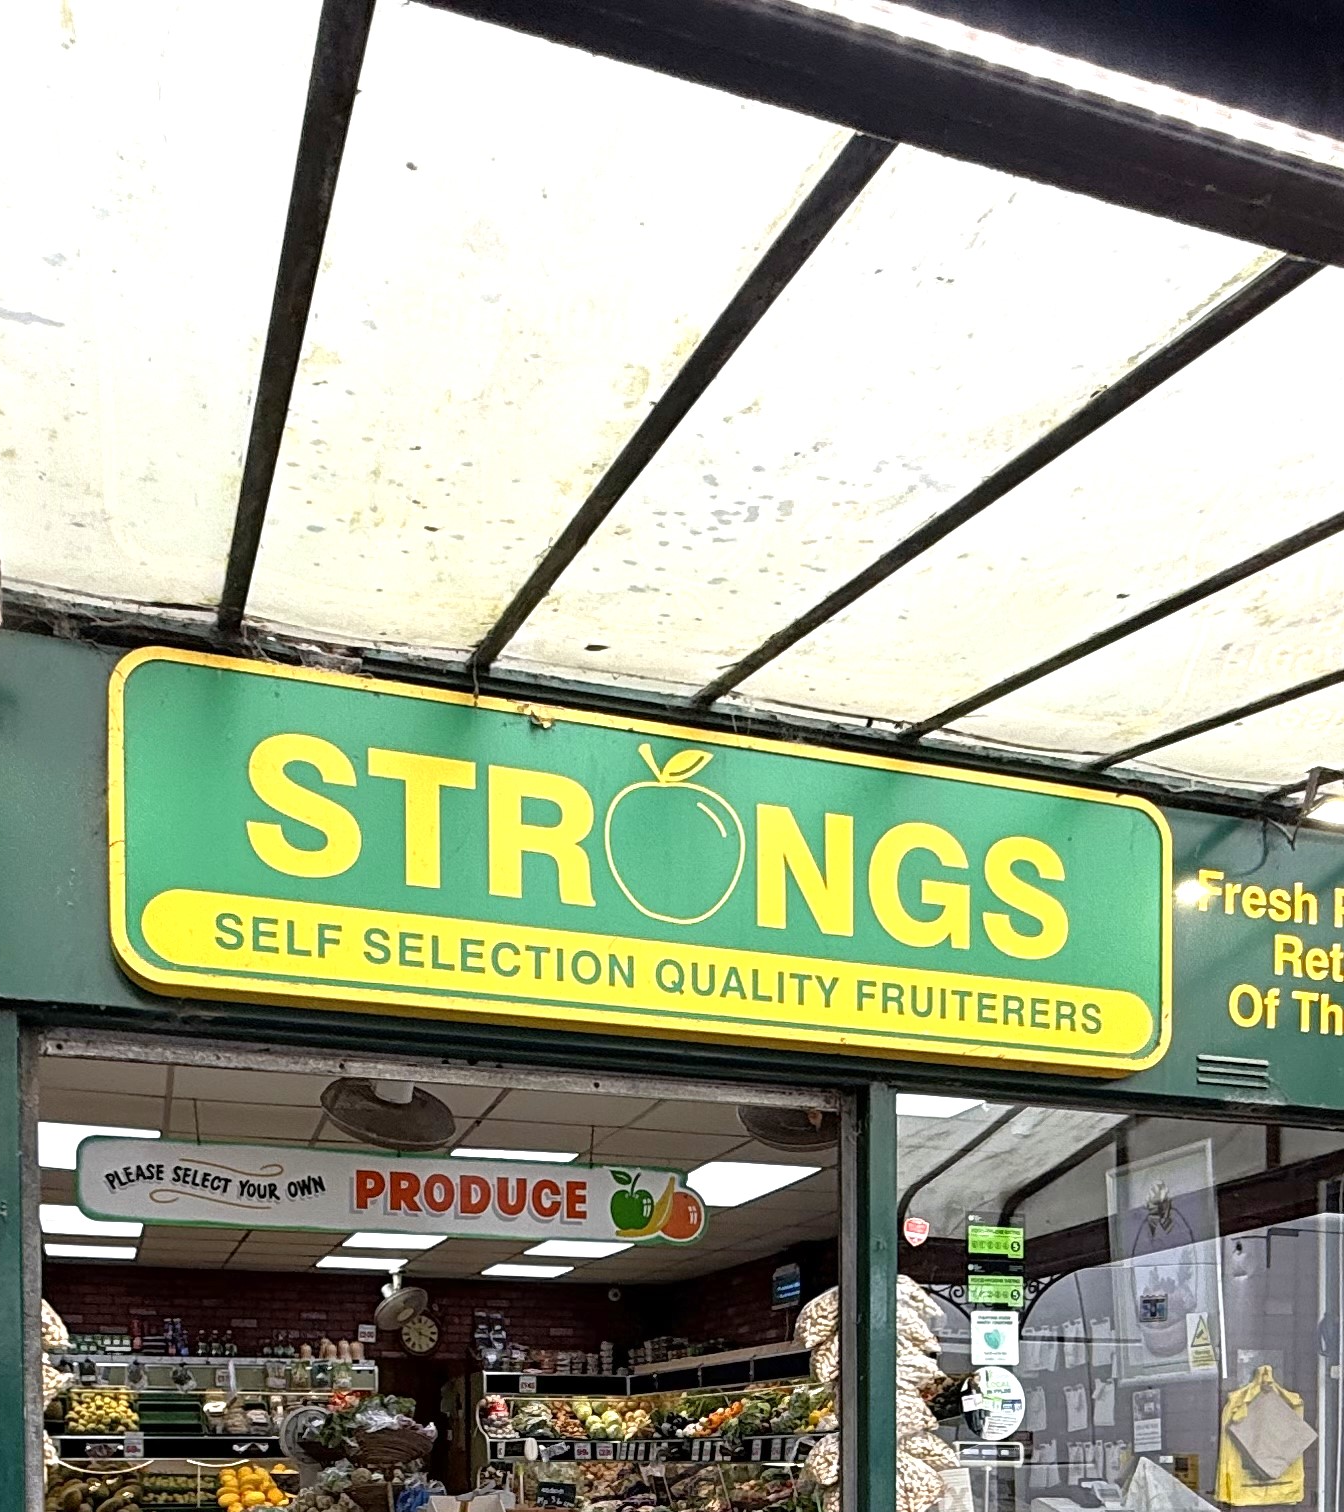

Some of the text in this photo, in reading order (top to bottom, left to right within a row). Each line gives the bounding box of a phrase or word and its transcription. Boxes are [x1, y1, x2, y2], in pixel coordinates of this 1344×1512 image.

[1197, 869, 1318, 926] Fresh
[214, 911, 1103, 1035] SELF SELECTION QUALITY FRUITERERS
[1228, 983, 1280, 1029] Of
[104, 1163, 327, 1201] PLEASE SELECT YOUR OWN
[355, 1169, 588, 1221] PRODUCE
